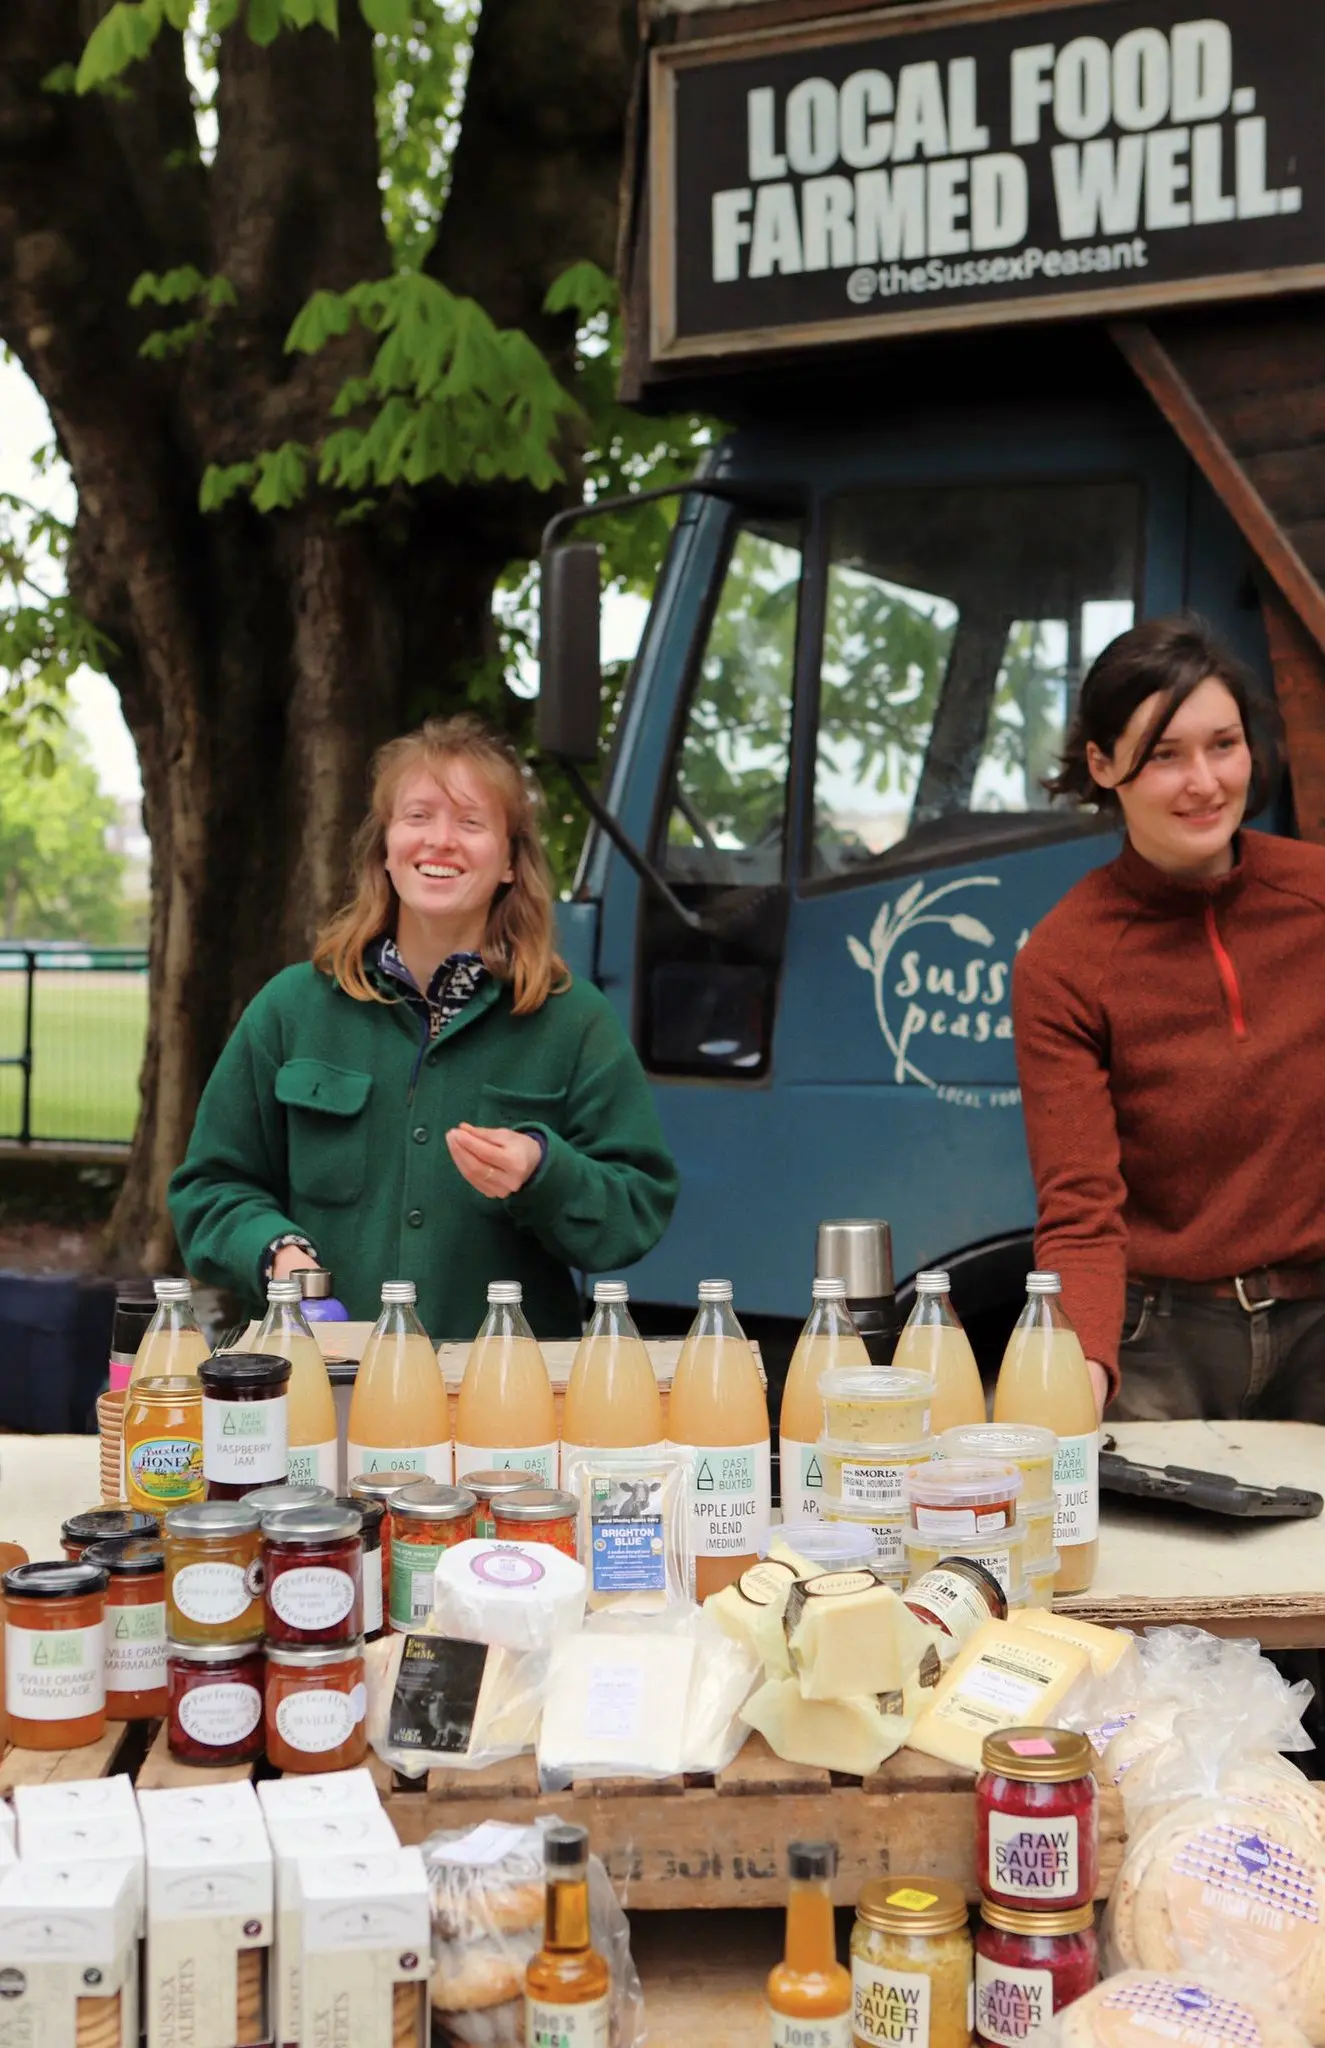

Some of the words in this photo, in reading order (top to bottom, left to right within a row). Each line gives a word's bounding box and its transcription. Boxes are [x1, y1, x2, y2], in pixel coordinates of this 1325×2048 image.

[748, 56, 988, 181] LOCAL
[1010, 19, 1256, 145] FOOD.
[711, 152, 1028, 282] FARMED
[1052, 116, 1302, 240] WELL.
[846, 238, 1147, 302] @theSussexPeasant
[895, 951, 1008, 1004] Suss
[895, 1002, 1015, 1084] peasa
[989, 1087, 1022, 1108] FOO
[143, 1444, 191, 1457] Buxted
[216, 1443, 272, 1454] RASPBERRY
[142, 1456, 195, 1468] HONEY
[233, 1456, 256, 1467] JAM
[390, 1459, 417, 1471] OAST
[524, 1457, 546, 1470] OAST
[722, 1457, 748, 1469] OAST
[1057, 1459, 1082, 1469] FARM
[290, 1468, 311, 1479] ARM
[722, 1468, 748, 1479] FARM
[854, 1469, 897, 1478] SMORLS
[1054, 1468, 1085, 1480] BUXTED
[719, 1478, 752, 1490] BUXTED
[1064, 1490, 1088, 1507] JUICE
[694, 1503, 727, 1518] APPLE
[729, 1500, 756, 1517] JUICE
[601, 1527, 655, 1538] BRIGHTON
[709, 1521, 742, 1534] BLEND
[614, 1537, 643, 1546] BLUE
[705, 1537, 746, 1549] (MEDIUM)
[104, 1657, 168, 1671] MARMALAD
[16, 1672, 51, 1686] SEVILLE
[55, 1669, 97, 1685] ORANGE
[22, 1683, 91, 1698] MARMALADE
[1020, 1831, 1070, 1849] RAW
[995, 1846, 1069, 1868] SAUER
[996, 1865, 1070, 1887] KRAUT
[872, 1981, 921, 2005] RAW
[994, 1979, 1043, 2001] RAW
[854, 1990, 920, 2025] SAUER
[978, 1988, 1042, 2021] SAUER
[854, 2011, 920, 2043] KRAUT
[785, 2023, 832, 2047] Joe's
